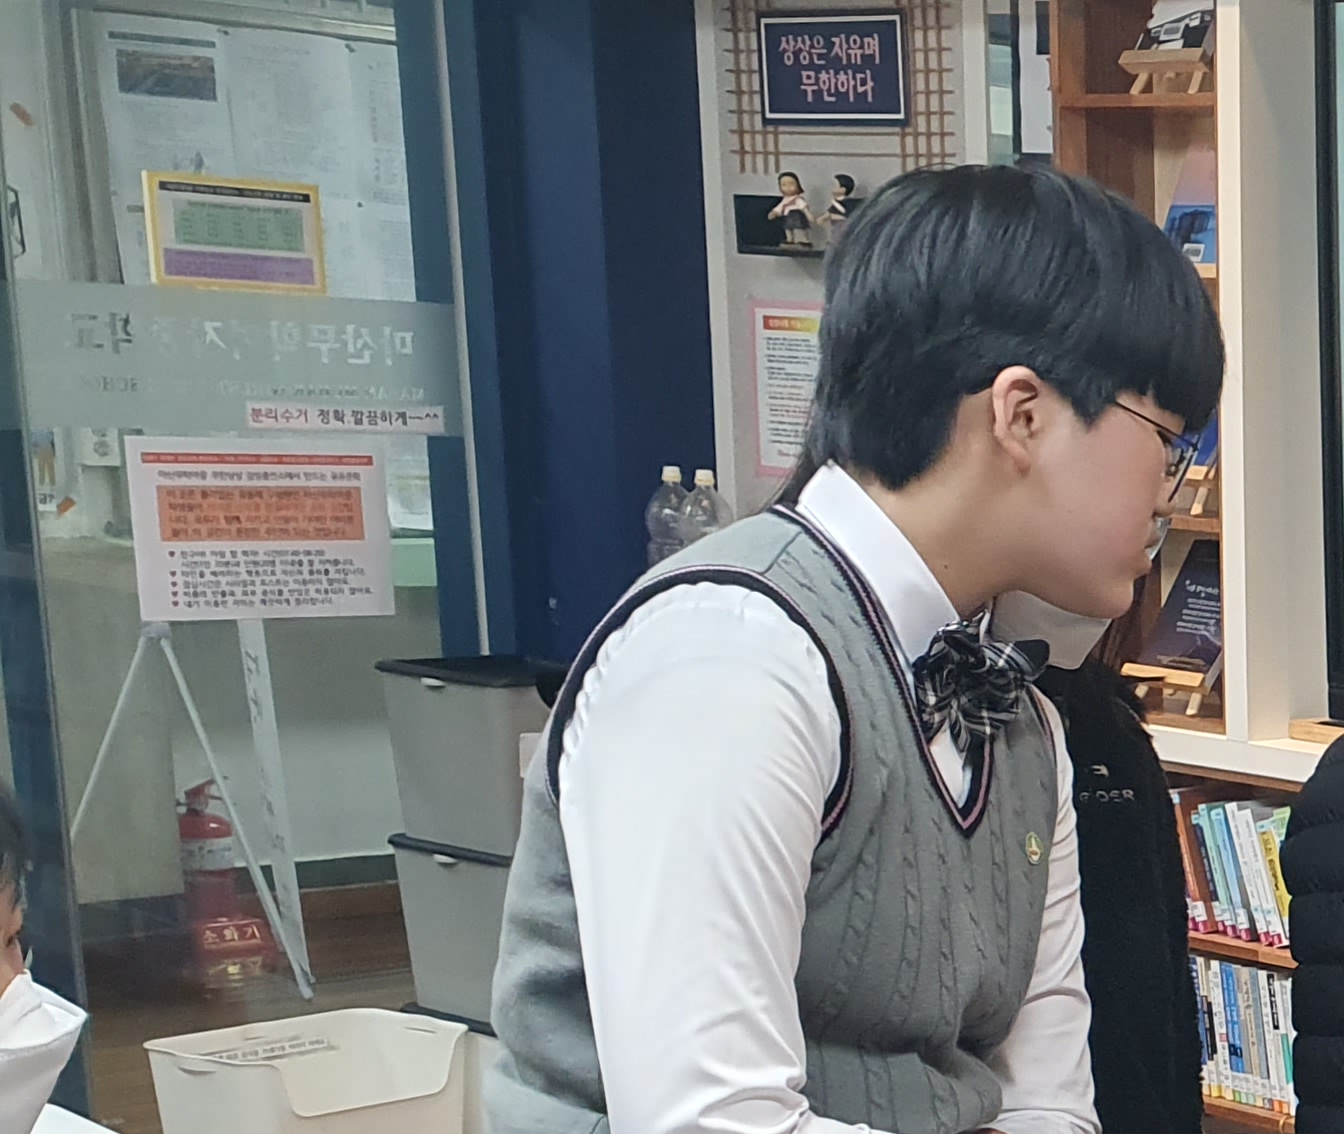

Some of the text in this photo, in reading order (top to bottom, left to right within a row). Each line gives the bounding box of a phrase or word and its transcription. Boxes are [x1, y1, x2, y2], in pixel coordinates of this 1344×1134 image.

[779, 33, 880, 65] 상상은 자유며
[800, 69, 875, 102] 무한하다
[250, 407, 308, 425] 분리수거
[203, 924, 262, 943] 소화기
